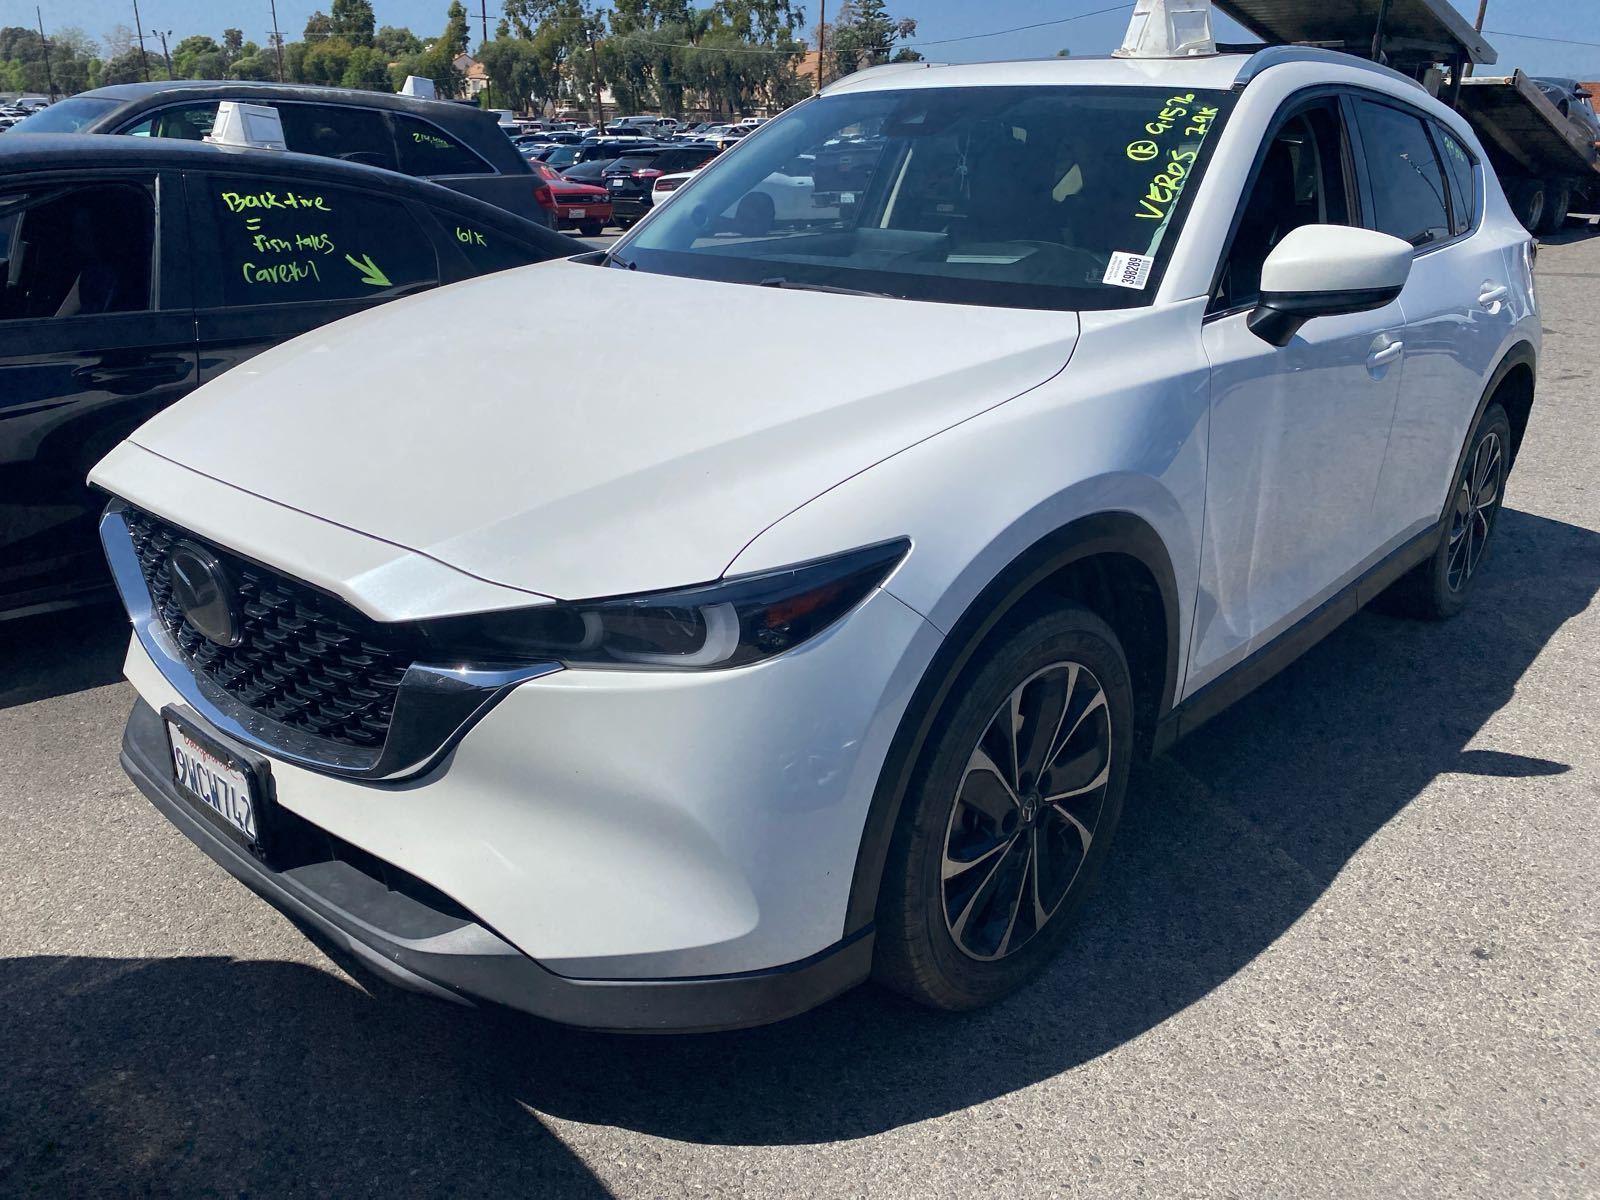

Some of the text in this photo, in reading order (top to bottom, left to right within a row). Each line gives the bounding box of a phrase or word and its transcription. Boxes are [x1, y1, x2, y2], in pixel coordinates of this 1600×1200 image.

[284, 192, 332, 211] tire
[1121, 257, 1143, 285] 398289
[175, 746, 256, 838] 9WCW742
